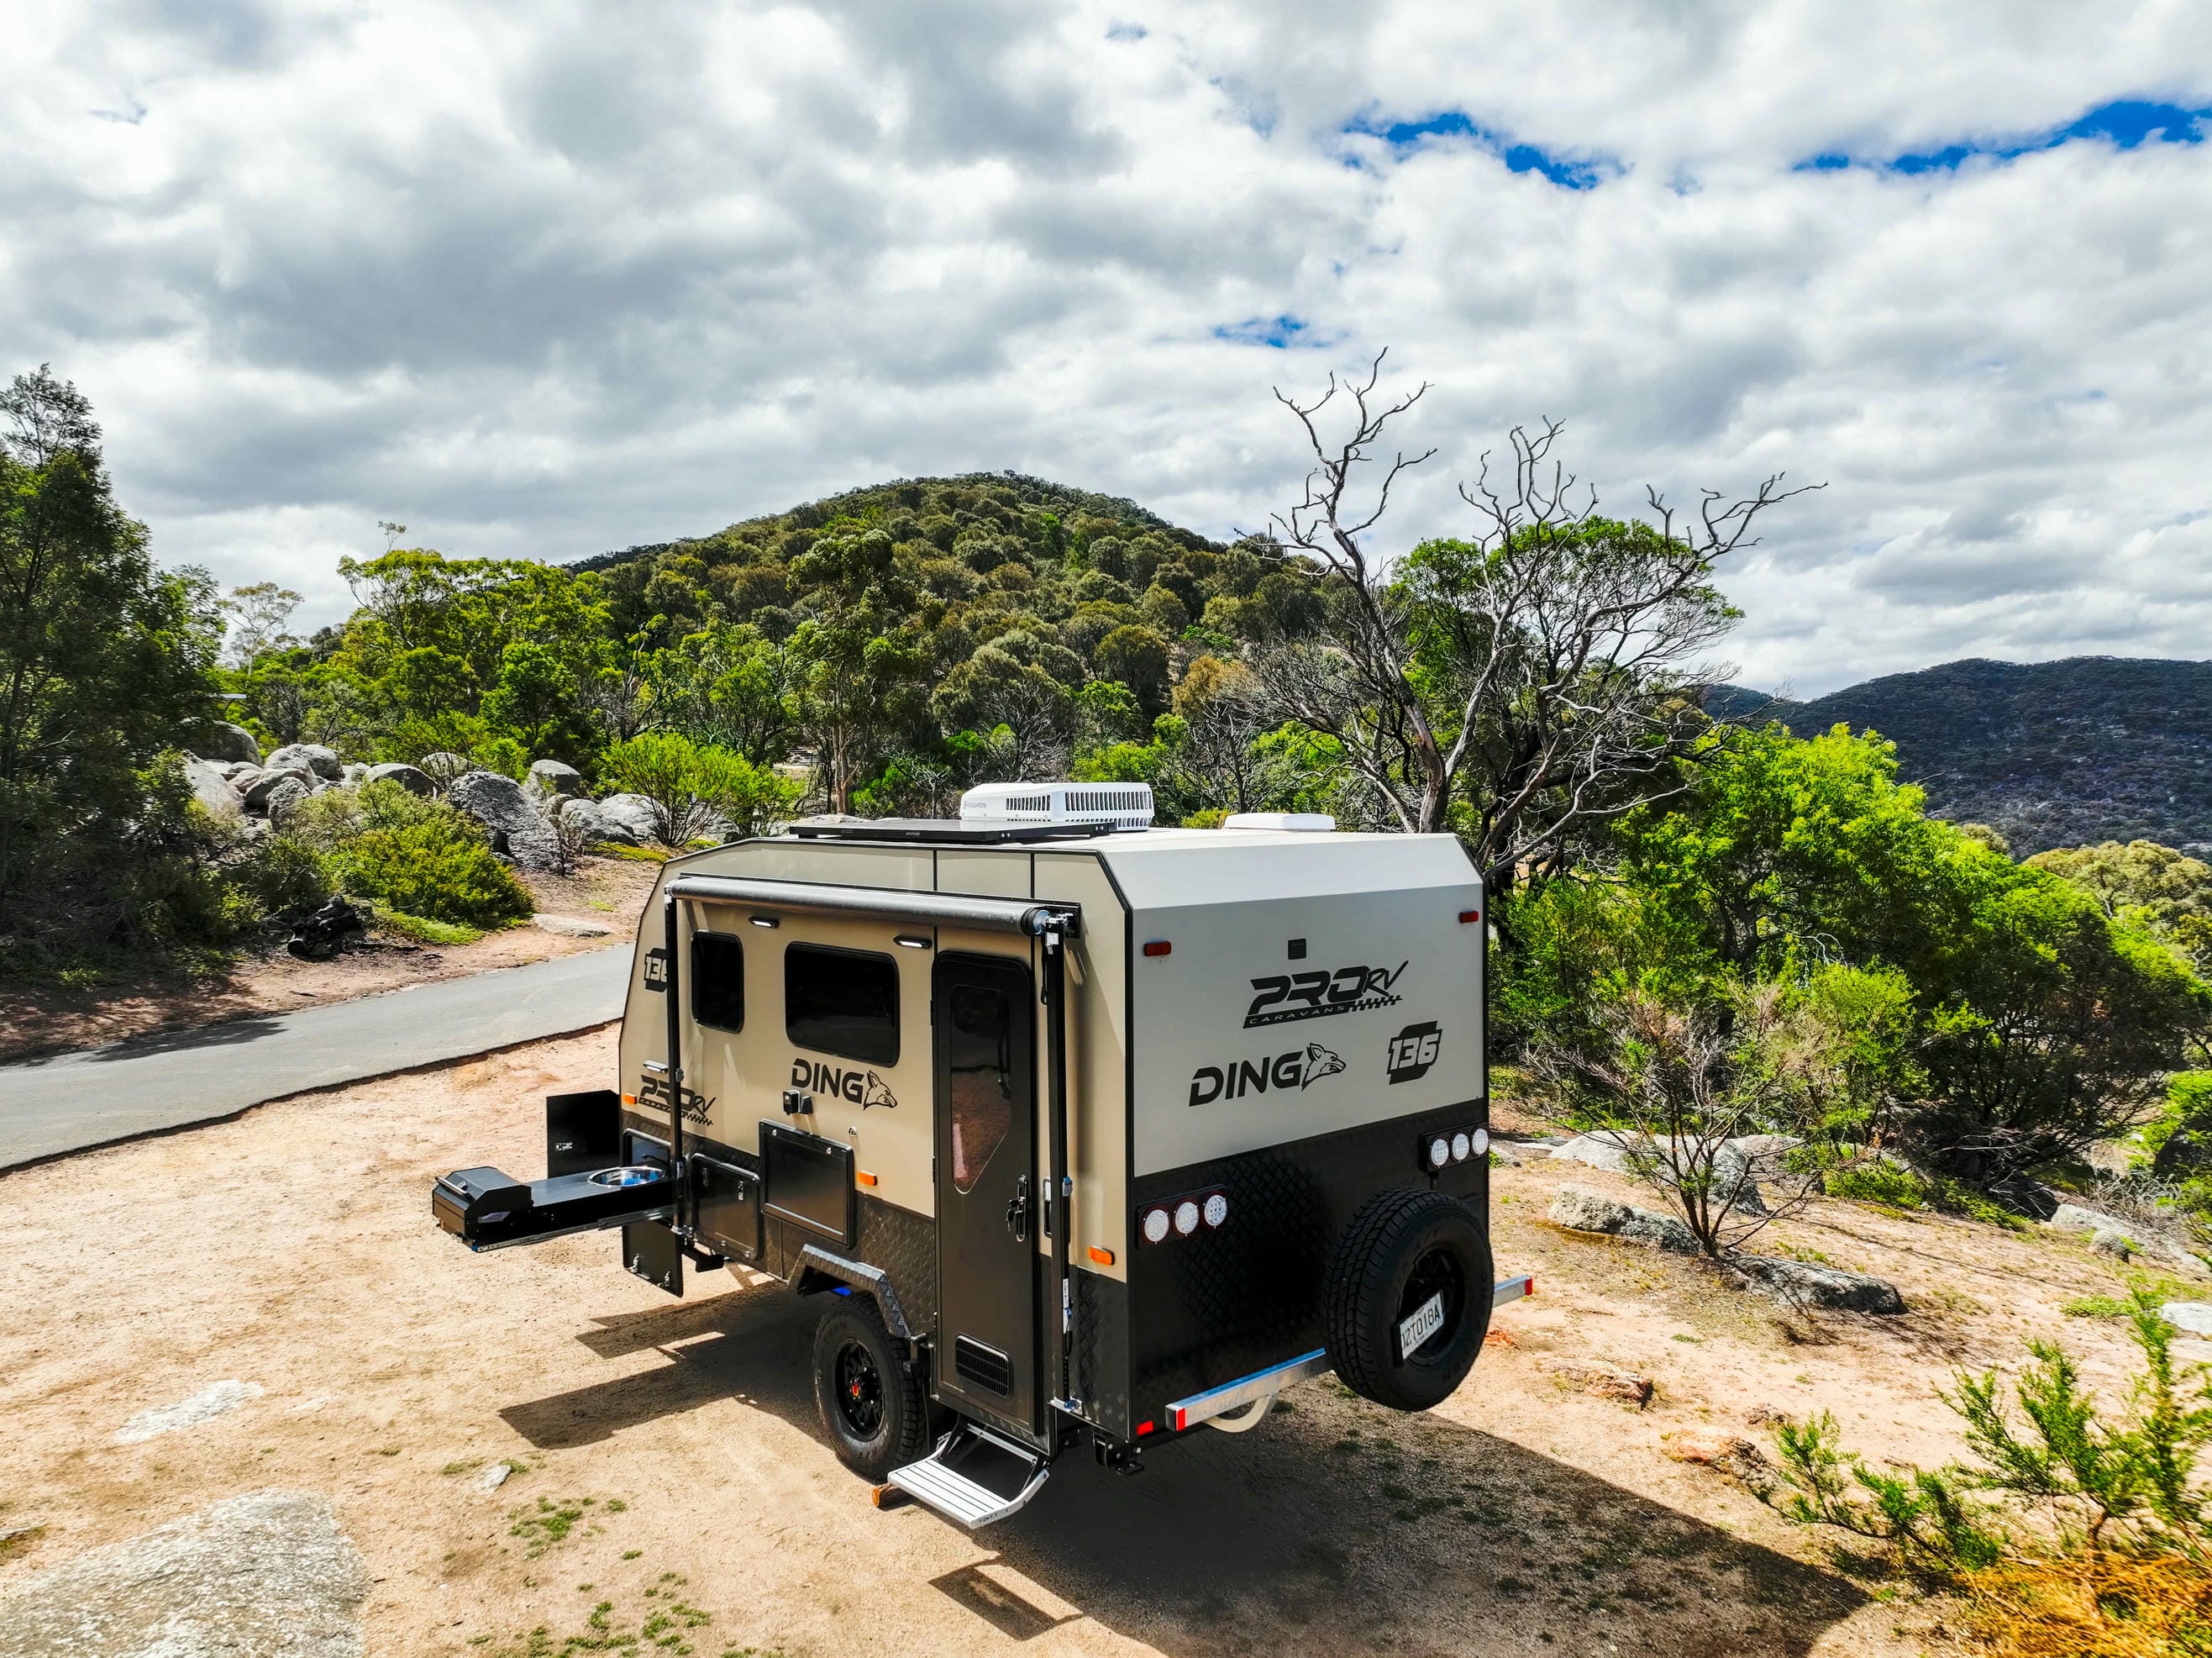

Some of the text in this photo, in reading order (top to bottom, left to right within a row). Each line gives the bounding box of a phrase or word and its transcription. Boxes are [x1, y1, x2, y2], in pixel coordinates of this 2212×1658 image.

[1247, 965, 1370, 1016] PRO
[1248, 1005, 1346, 1024] CARAVANS
[1389, 1032, 1441, 1071] 136
